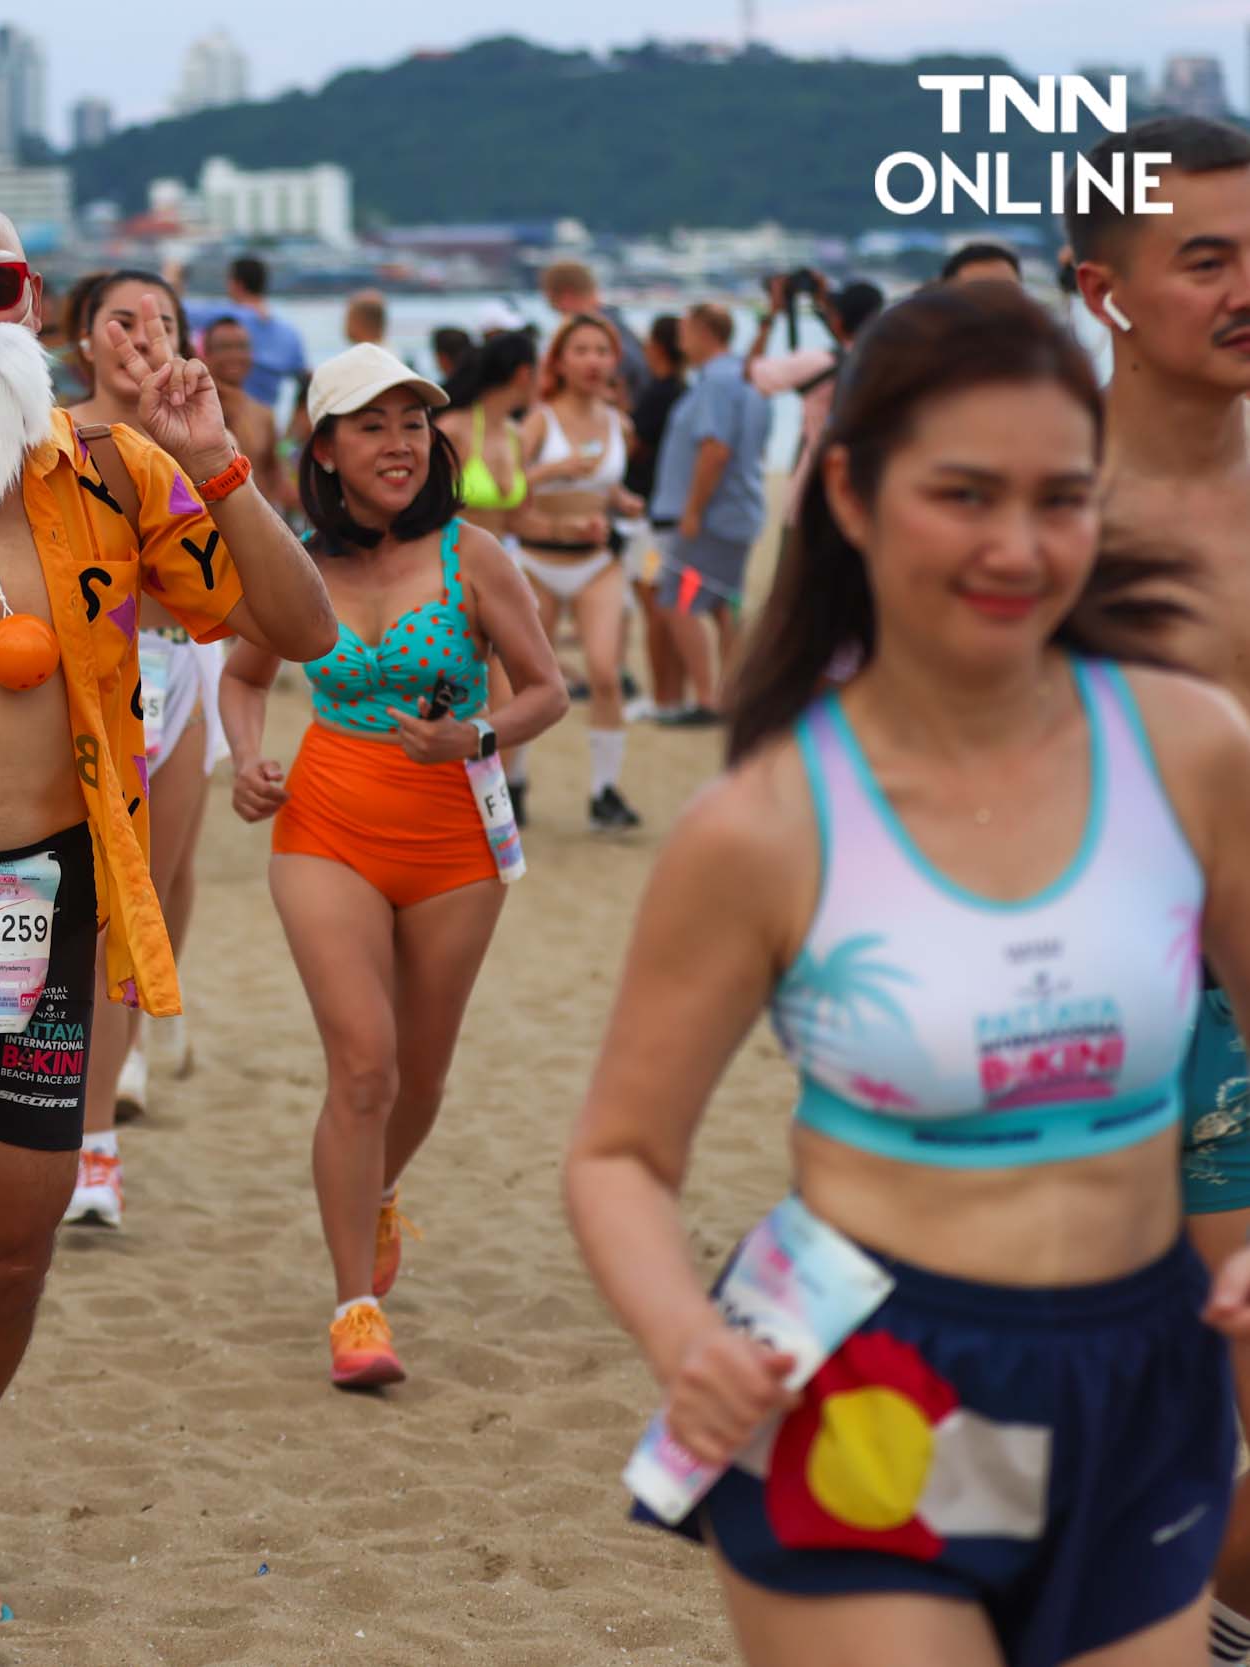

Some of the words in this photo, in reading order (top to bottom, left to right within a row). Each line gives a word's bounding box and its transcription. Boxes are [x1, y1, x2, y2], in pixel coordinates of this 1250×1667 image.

[180, 530, 219, 590] Y
[5, 1034, 84, 1051] INTERNATIONAL
[0, 1067, 35, 1082] BEACH
[36, 1073, 62, 1085] RACE
[63, 1074, 81, 1085] 2023
